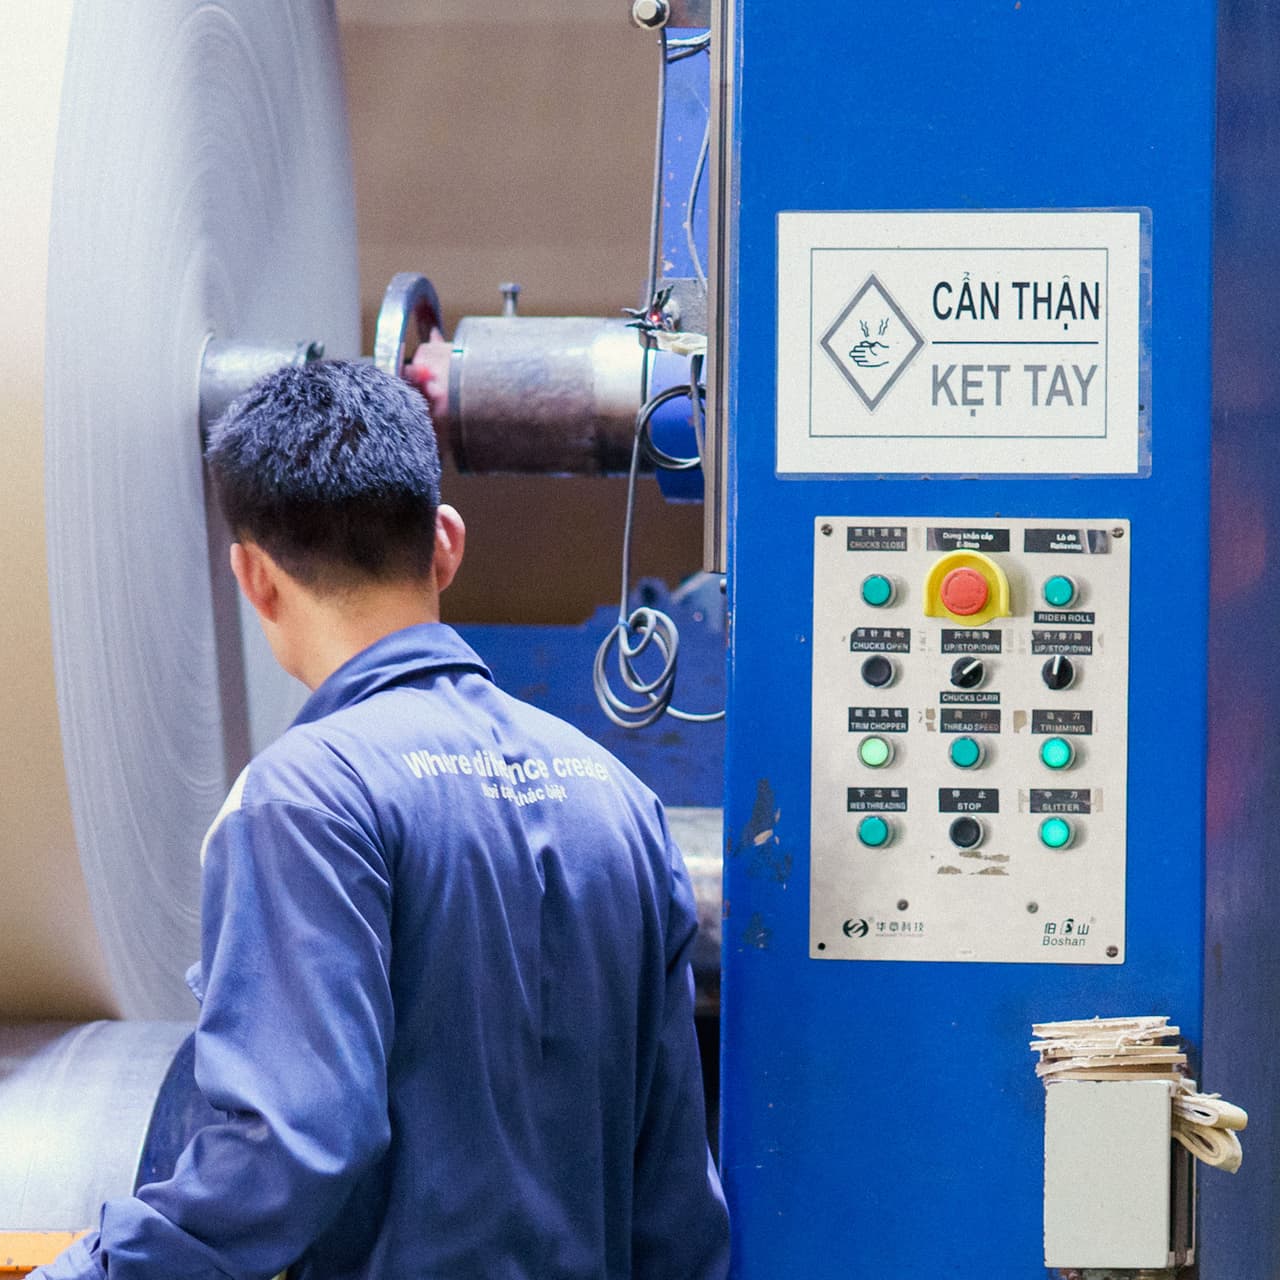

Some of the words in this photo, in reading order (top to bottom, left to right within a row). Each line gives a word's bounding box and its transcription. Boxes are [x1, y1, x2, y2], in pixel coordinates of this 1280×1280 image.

[932, 272, 1000, 321] CẨN
[1012, 275, 1100, 330] THẬN
[931, 364, 1011, 417] KẸT
[1024, 364, 1098, 407] TAY
[1038, 613, 1067, 623] RIDER
[1067, 614, 1092, 623] ROLL
[852, 641, 885, 650] CHUCKS
[942, 693, 975, 702] CHUCKS
[870, 722, 907, 731] CHOPPER
[943, 723, 974, 731] THREAD
[1040, 723, 1086, 733] TRIMMING
[957, 802, 982, 811] STOP
[1041, 803, 1080, 812] SLITTER
[1042, 935, 1086, 946] Boshan
